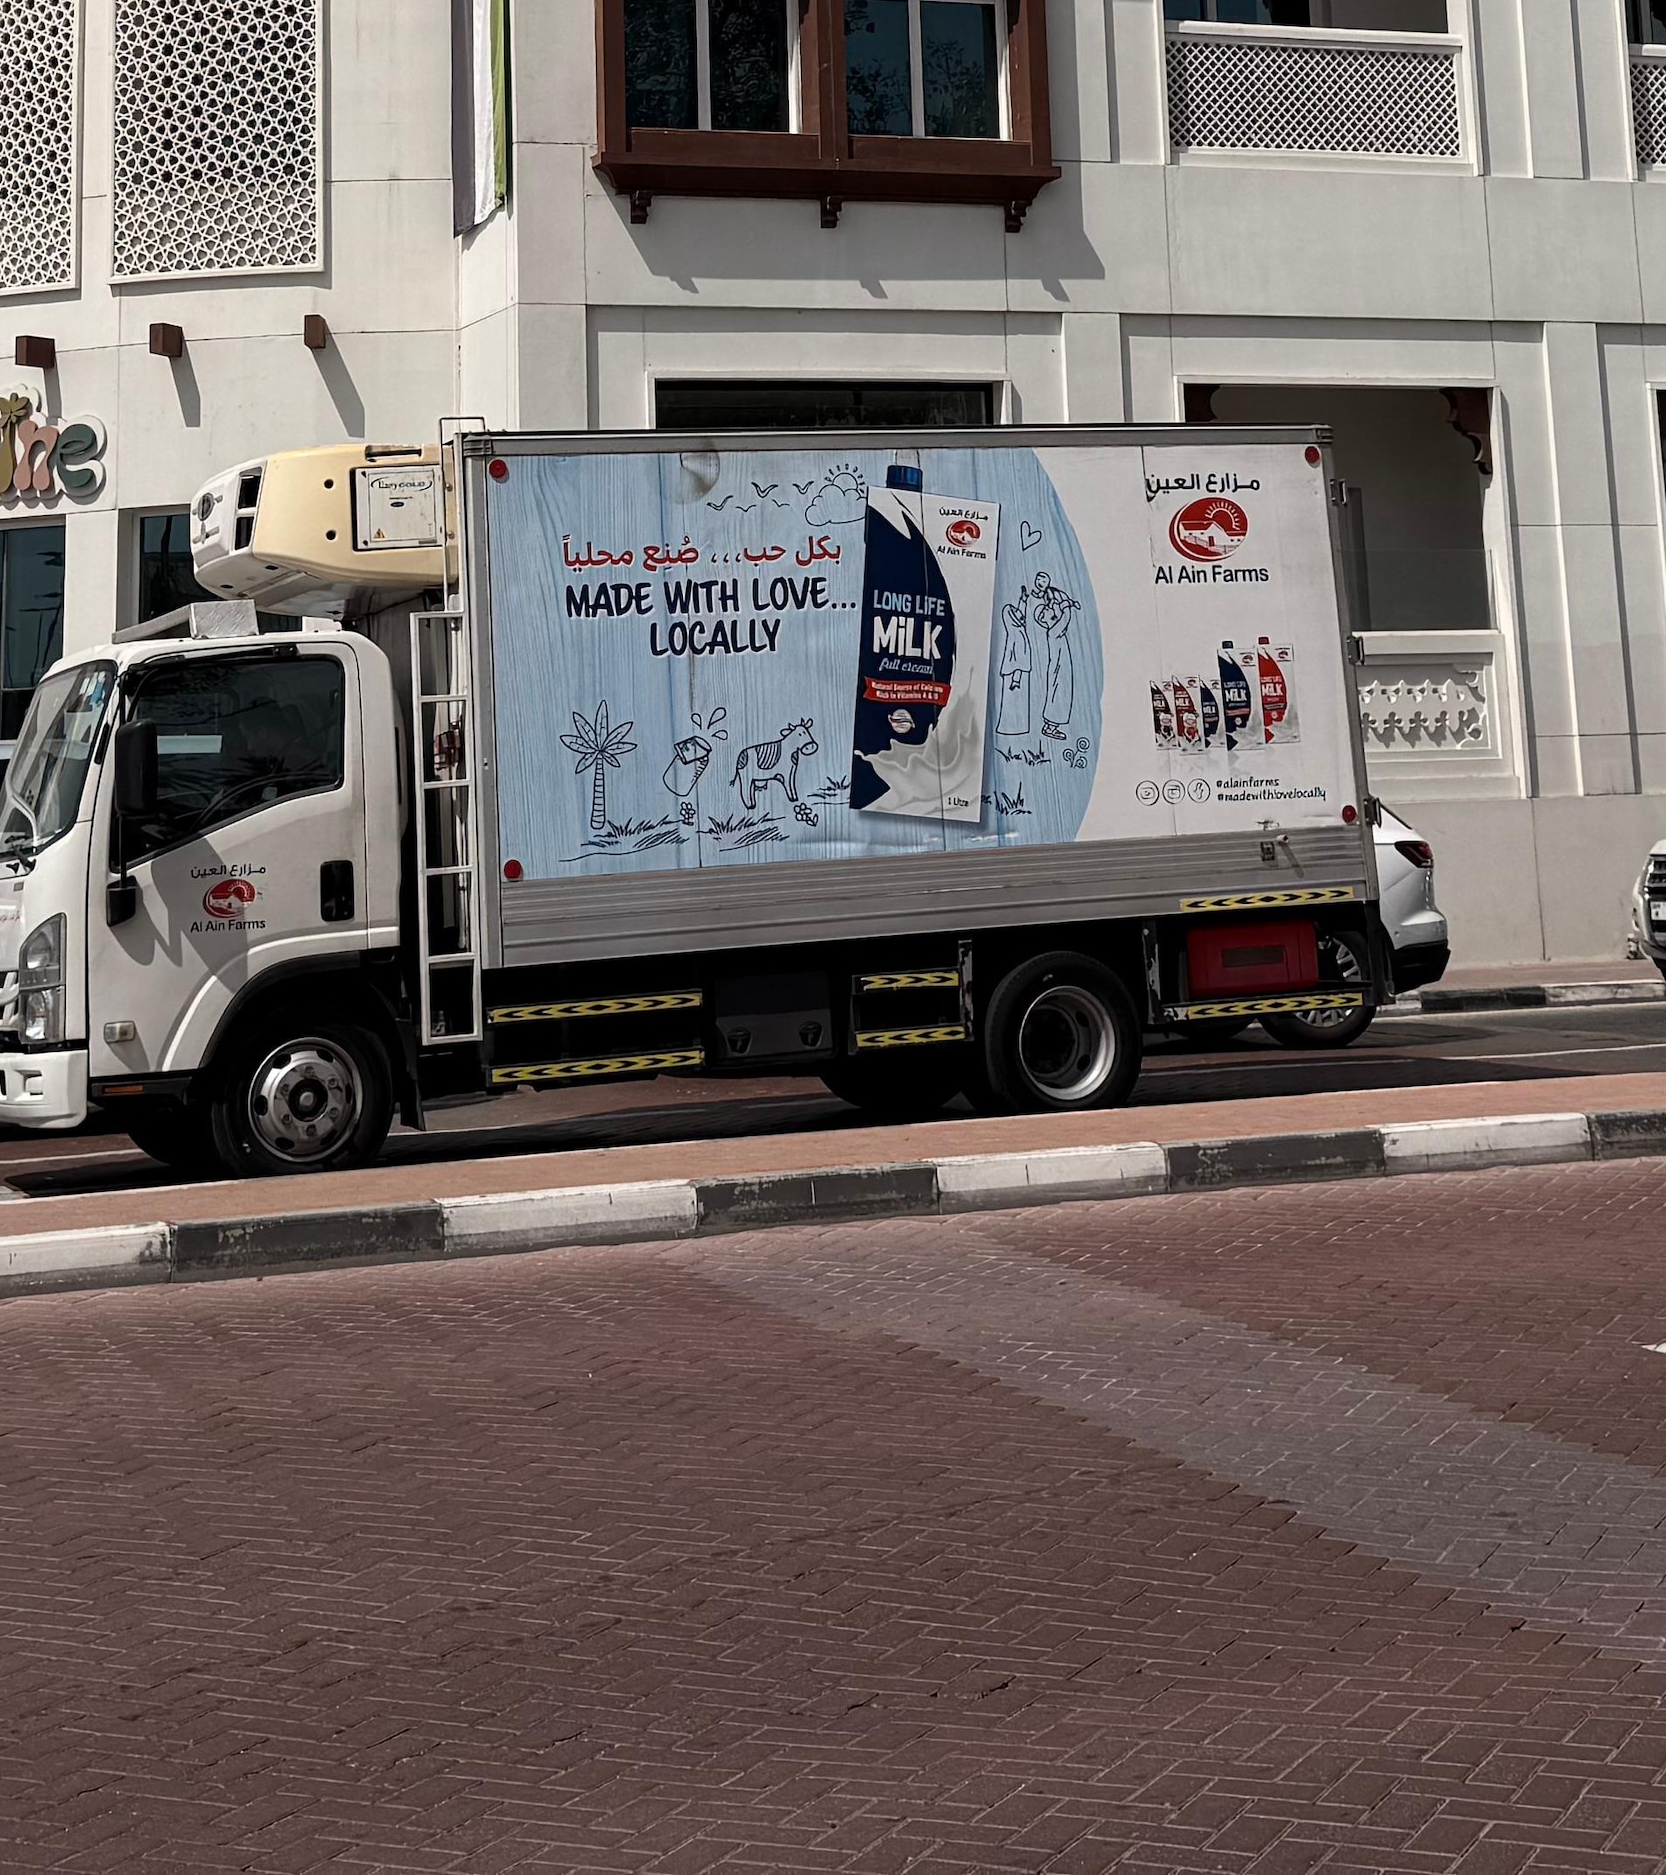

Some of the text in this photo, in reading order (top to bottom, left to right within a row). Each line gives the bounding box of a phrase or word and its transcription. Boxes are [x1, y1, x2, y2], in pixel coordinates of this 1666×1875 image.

[1145, 472, 1261, 495] مزارع العين
[795, 535, 842, 567] بكل
[1155, 564, 1270, 584] Al Ain Farms
[565, 581, 654, 618] MADE
[663, 578, 740, 614] WITH
[873, 589, 946, 617] LONG LIFE
[649, 618, 781, 657] LOCALLY
[190, 862, 267, 879] مزارع العين
[190, 919, 267, 933] Al Ain Farms
